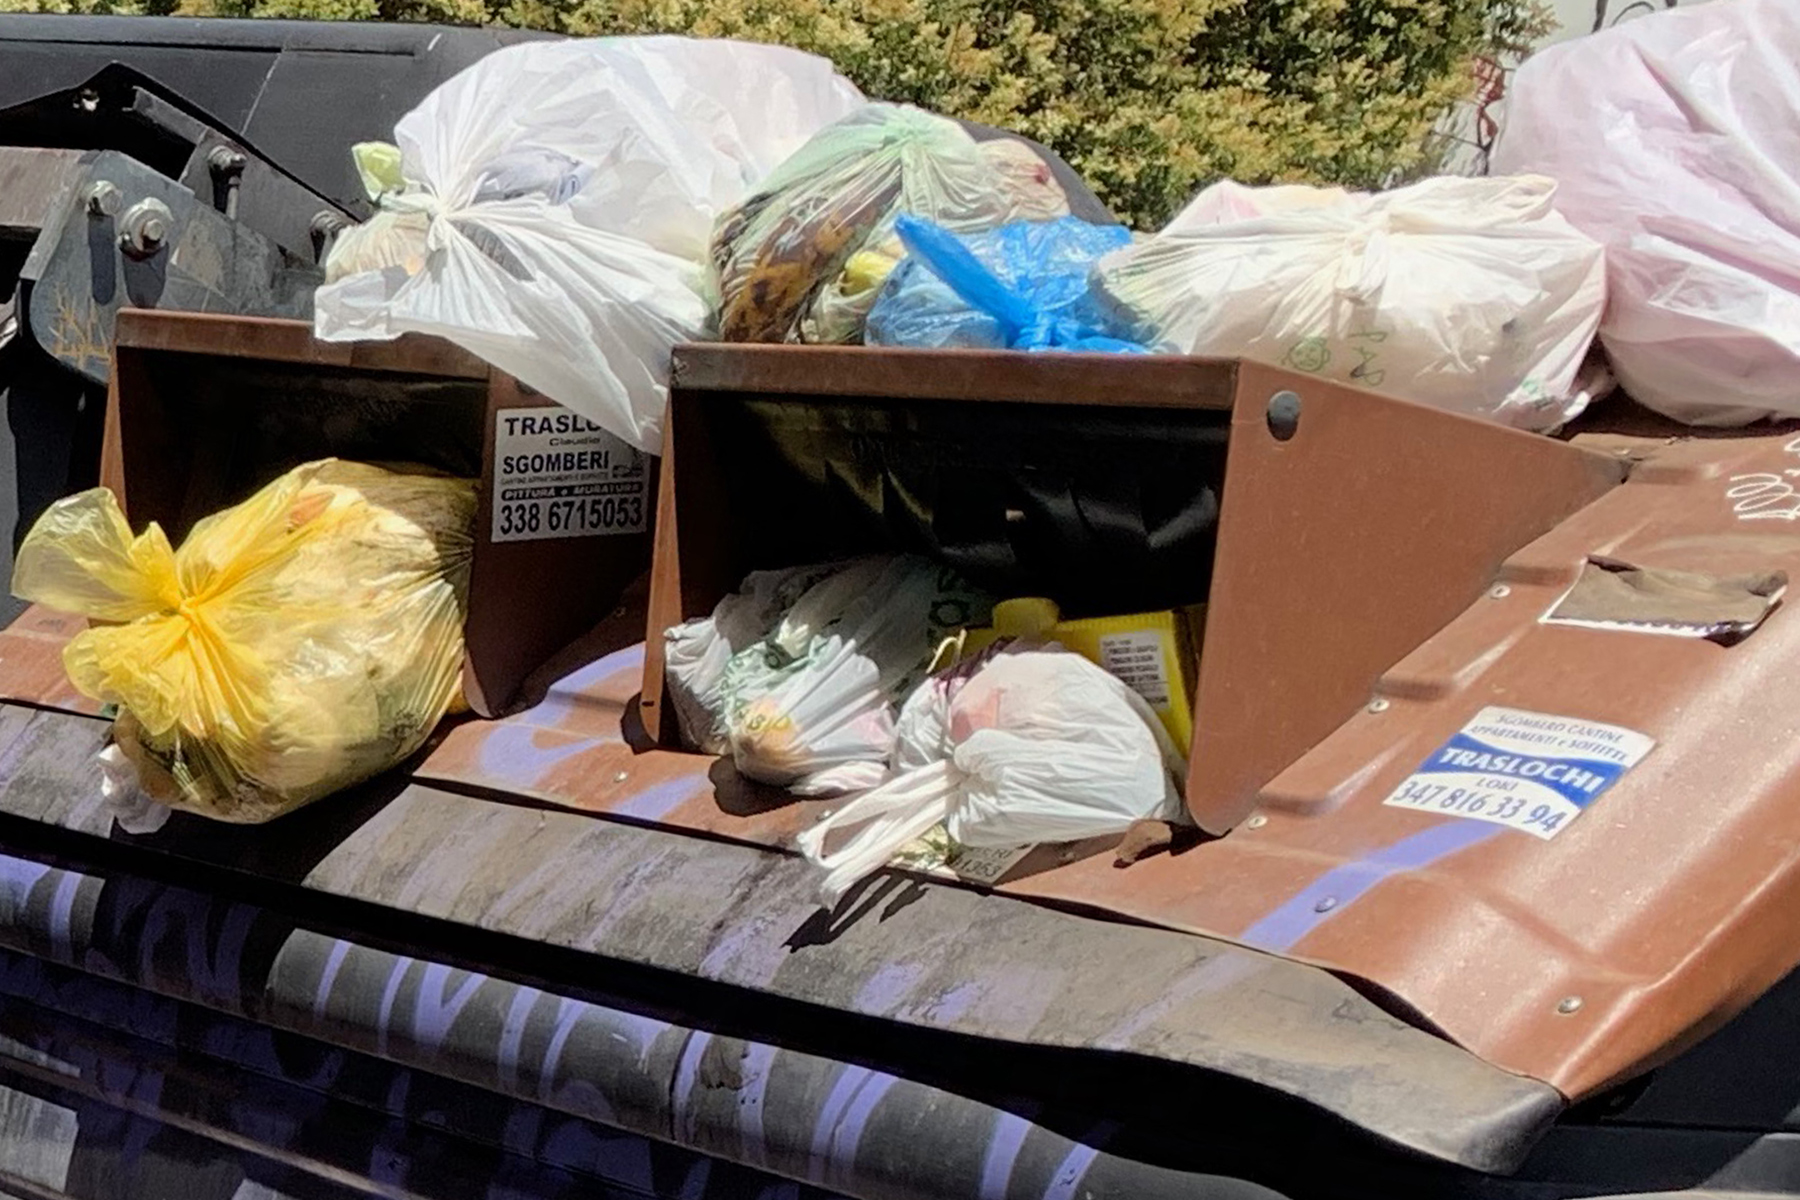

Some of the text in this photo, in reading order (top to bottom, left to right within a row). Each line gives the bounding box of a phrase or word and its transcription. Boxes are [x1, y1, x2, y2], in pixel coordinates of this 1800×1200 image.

[504, 414, 601, 436] TRASLO
[502, 450, 609, 475] SGOMBERI
[504, 489, 555, 500] PITTURA
[573, 483, 640, 495] MURATURA
[500, 498, 643, 535] 338 6715053
[1470, 725, 1556, 747] APPARTAMENTI
[1496, 713, 1624, 743] SGOMBERO CANTINE
[1438, 747, 1605, 793] TRASLOCHI
[1392, 781, 1567, 832] 347 816 33 94
